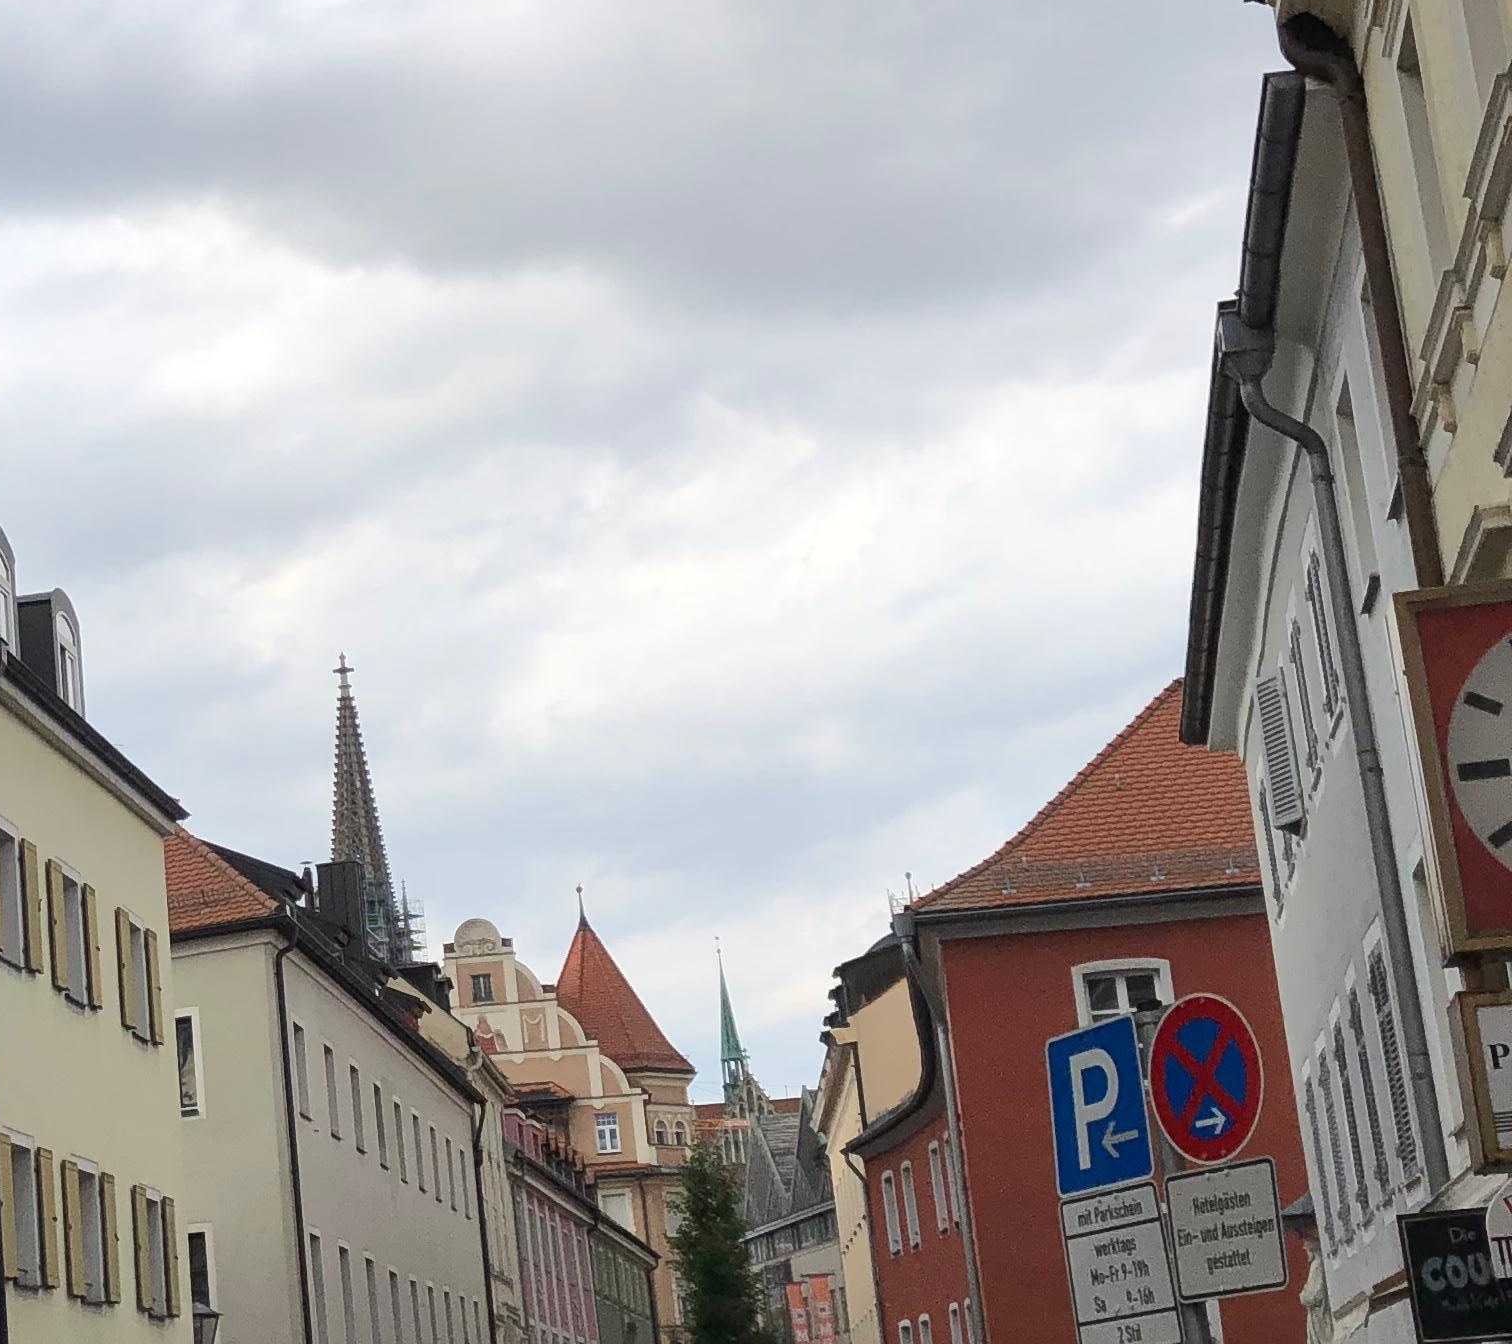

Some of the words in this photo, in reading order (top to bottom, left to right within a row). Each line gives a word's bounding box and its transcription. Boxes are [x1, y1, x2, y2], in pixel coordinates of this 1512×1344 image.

[1069, 1047, 1120, 1172] P
[1077, 1210, 1092, 1228] mit
[1094, 1198, 1144, 1225] Parkschein
[1192, 1192, 1251, 1216] Hotelgästen
[1177, 1228, 1199, 1248] Ein-
[1200, 1222, 1219, 1244] und
[1221, 1216, 1275, 1239] Aussteigen
[1095, 1236, 1138, 1258] werktags
[1090, 1264, 1120, 1287] Mo-Fr
[1121, 1258, 1151, 1281] 9-19h
[1206, 1248, 1252, 1276] gestattet
[1421, 1252, 1491, 1292] COU
[1093, 1296, 1108, 1314] Sa
[1125, 1286, 1156, 1306] 9-16h
[1117, 1325, 1125, 1344] 2
